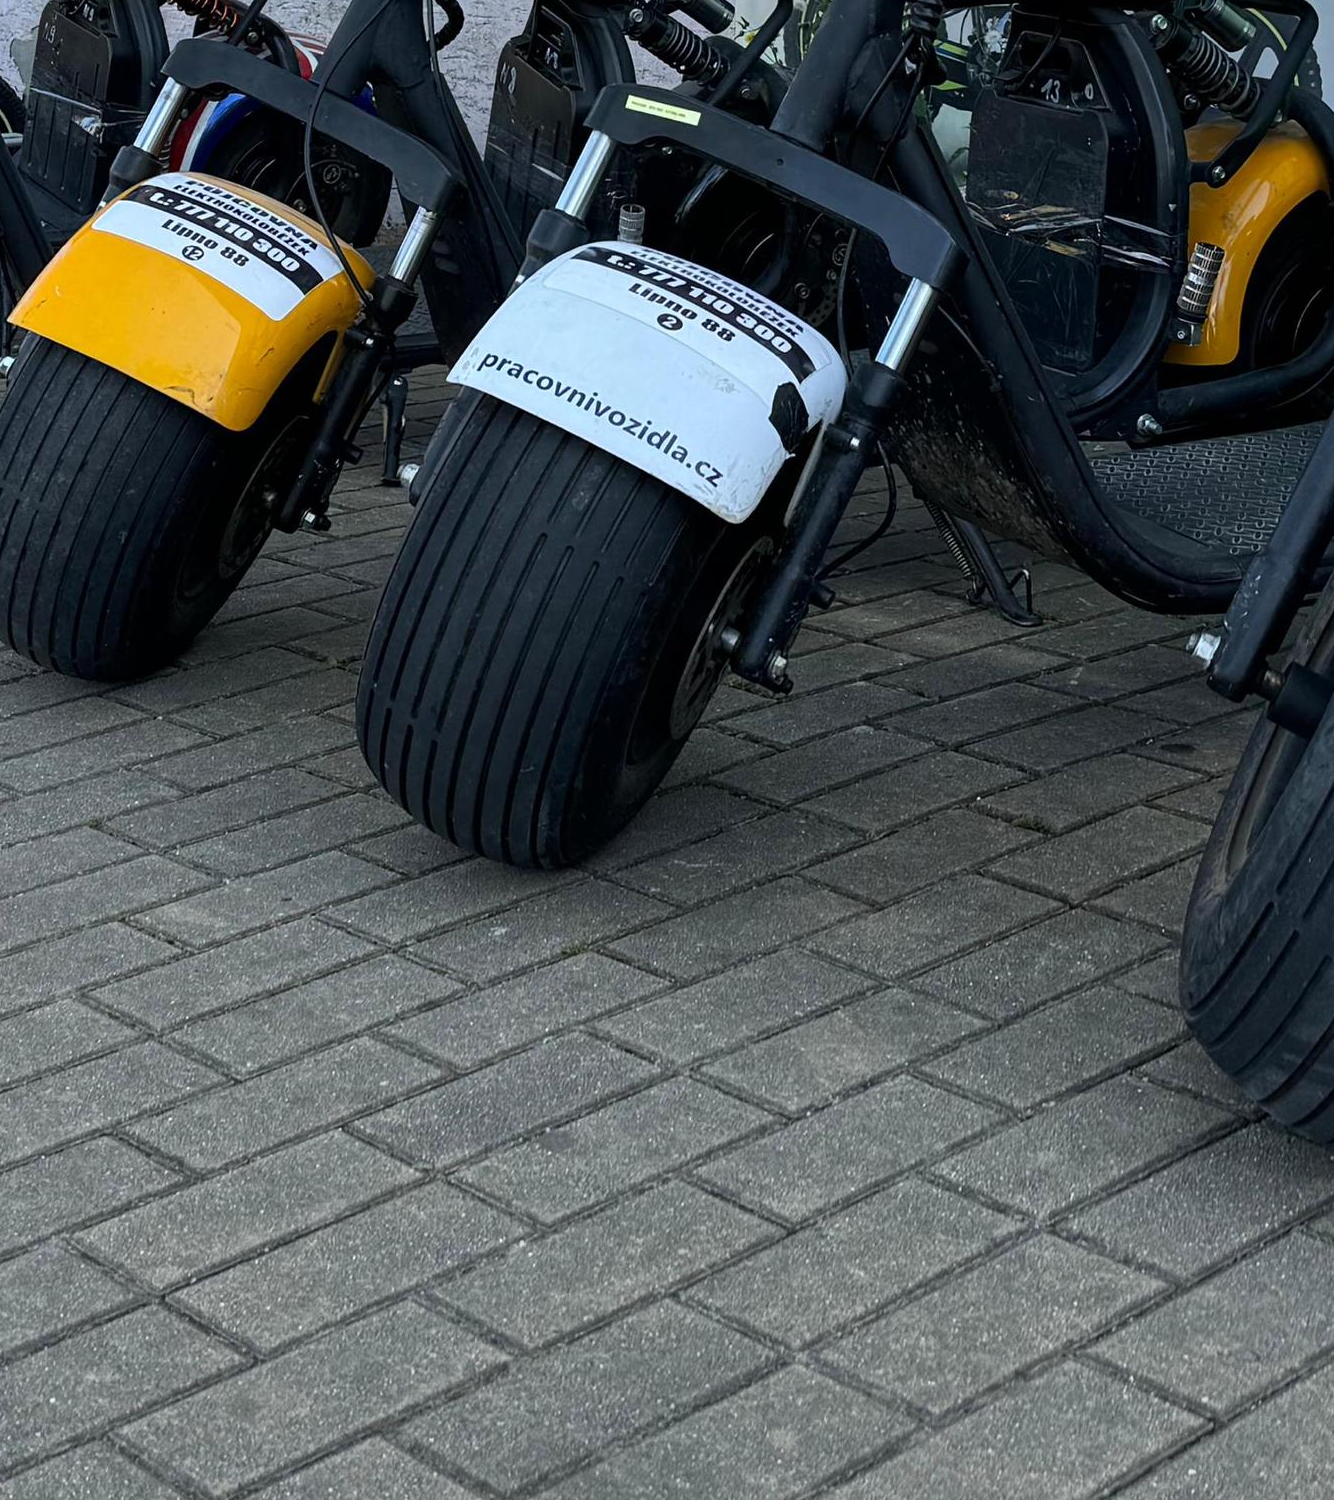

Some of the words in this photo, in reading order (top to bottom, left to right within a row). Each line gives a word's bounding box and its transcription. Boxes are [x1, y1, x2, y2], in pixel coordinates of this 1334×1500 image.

[161, 219, 219, 250] Lipno
[220, 247, 250, 267] 88
[174, 199, 217, 220] 777
[214, 217, 254, 241] 110
[252, 239, 300, 272] 300
[628, 282, 698, 320] Lipno
[701, 318, 736, 342] 88
[638, 264, 687, 288] 777
[688, 285, 735, 315] 110
[735, 312, 793, 354] 300
[478, 350, 724, 489] pracovnivozidla.cz
